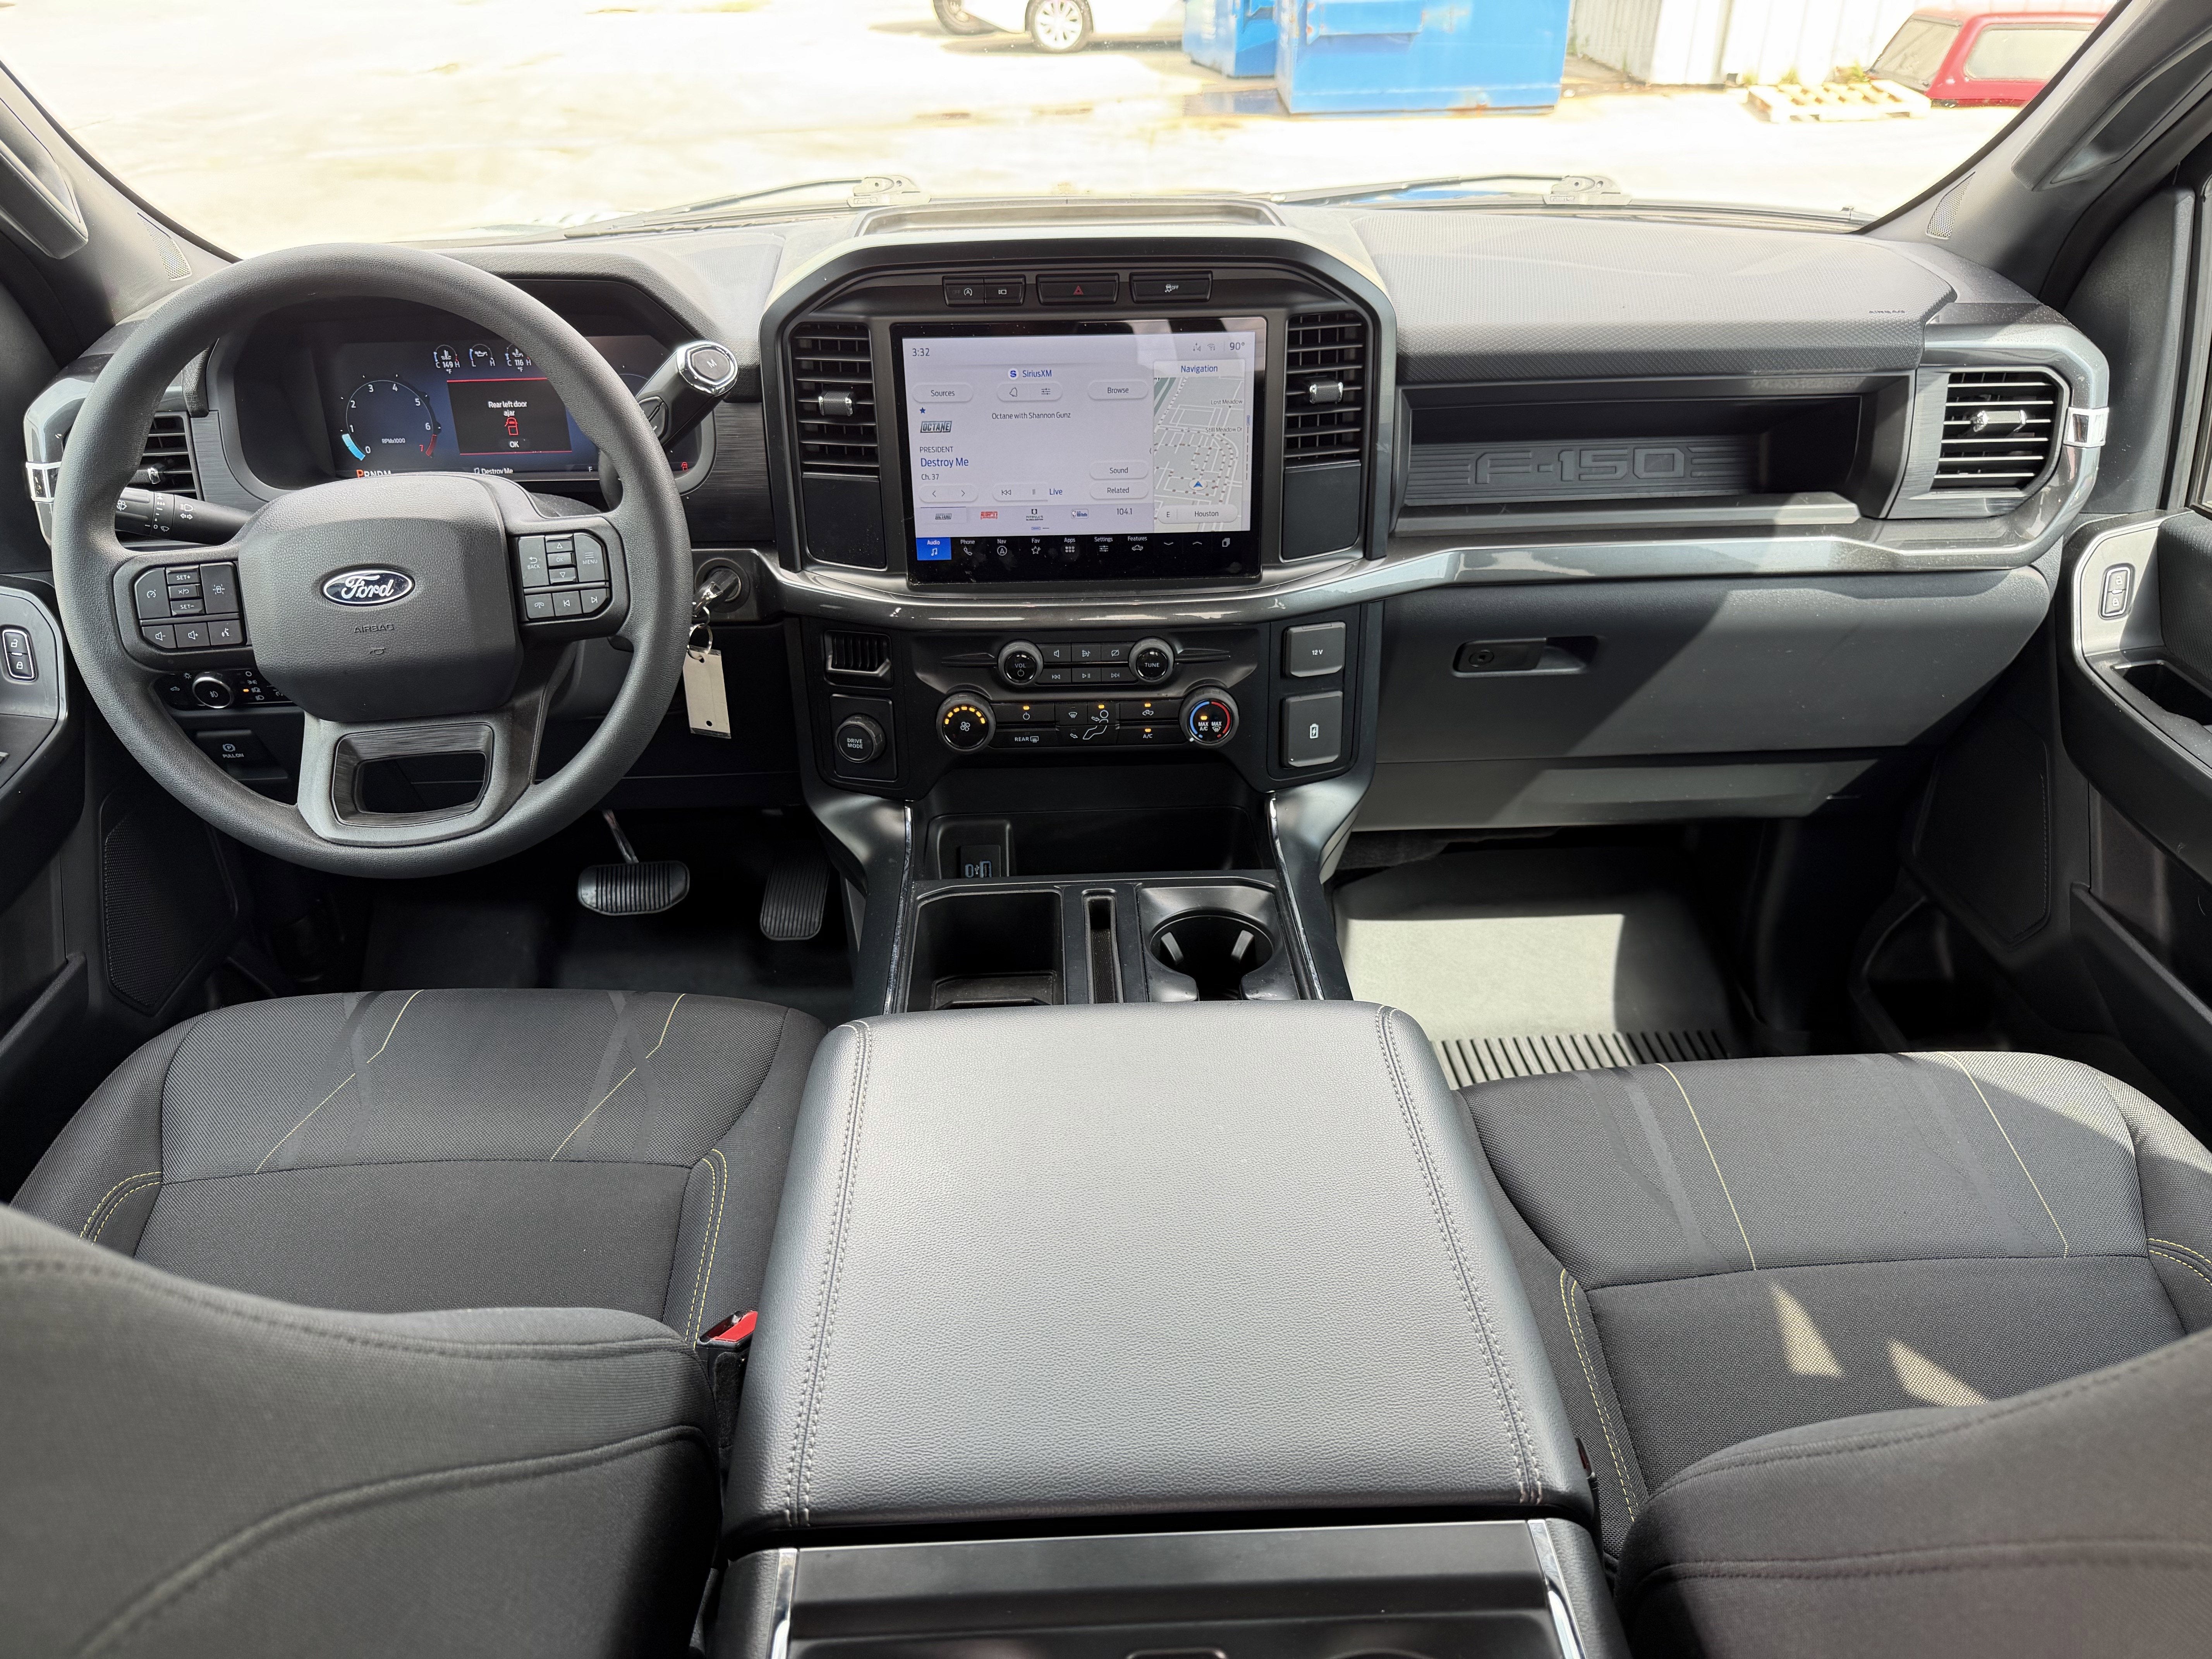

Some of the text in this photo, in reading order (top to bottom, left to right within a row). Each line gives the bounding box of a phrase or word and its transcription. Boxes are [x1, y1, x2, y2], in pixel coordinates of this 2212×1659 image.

[1230, 342, 1245, 350] 90°
[912, 348, 930, 357] 3:32
[706, 359, 717, 368] M
[1022, 369, 1052, 378] SiriusXM
[1181, 365, 1218, 374] Navigation
[368, 384, 374, 392] 3
[392, 383, 398, 392] 4
[350, 400, 356, 408] 2
[415, 398, 421, 406] 5
[922, 422, 951, 432] OCTANE
[921, 457, 969, 468] Destroy Me
[1475, 447, 1685, 484] F-150
[341, 575, 394, 599] Ford
[354, 623, 395, 633] AIRBAG
